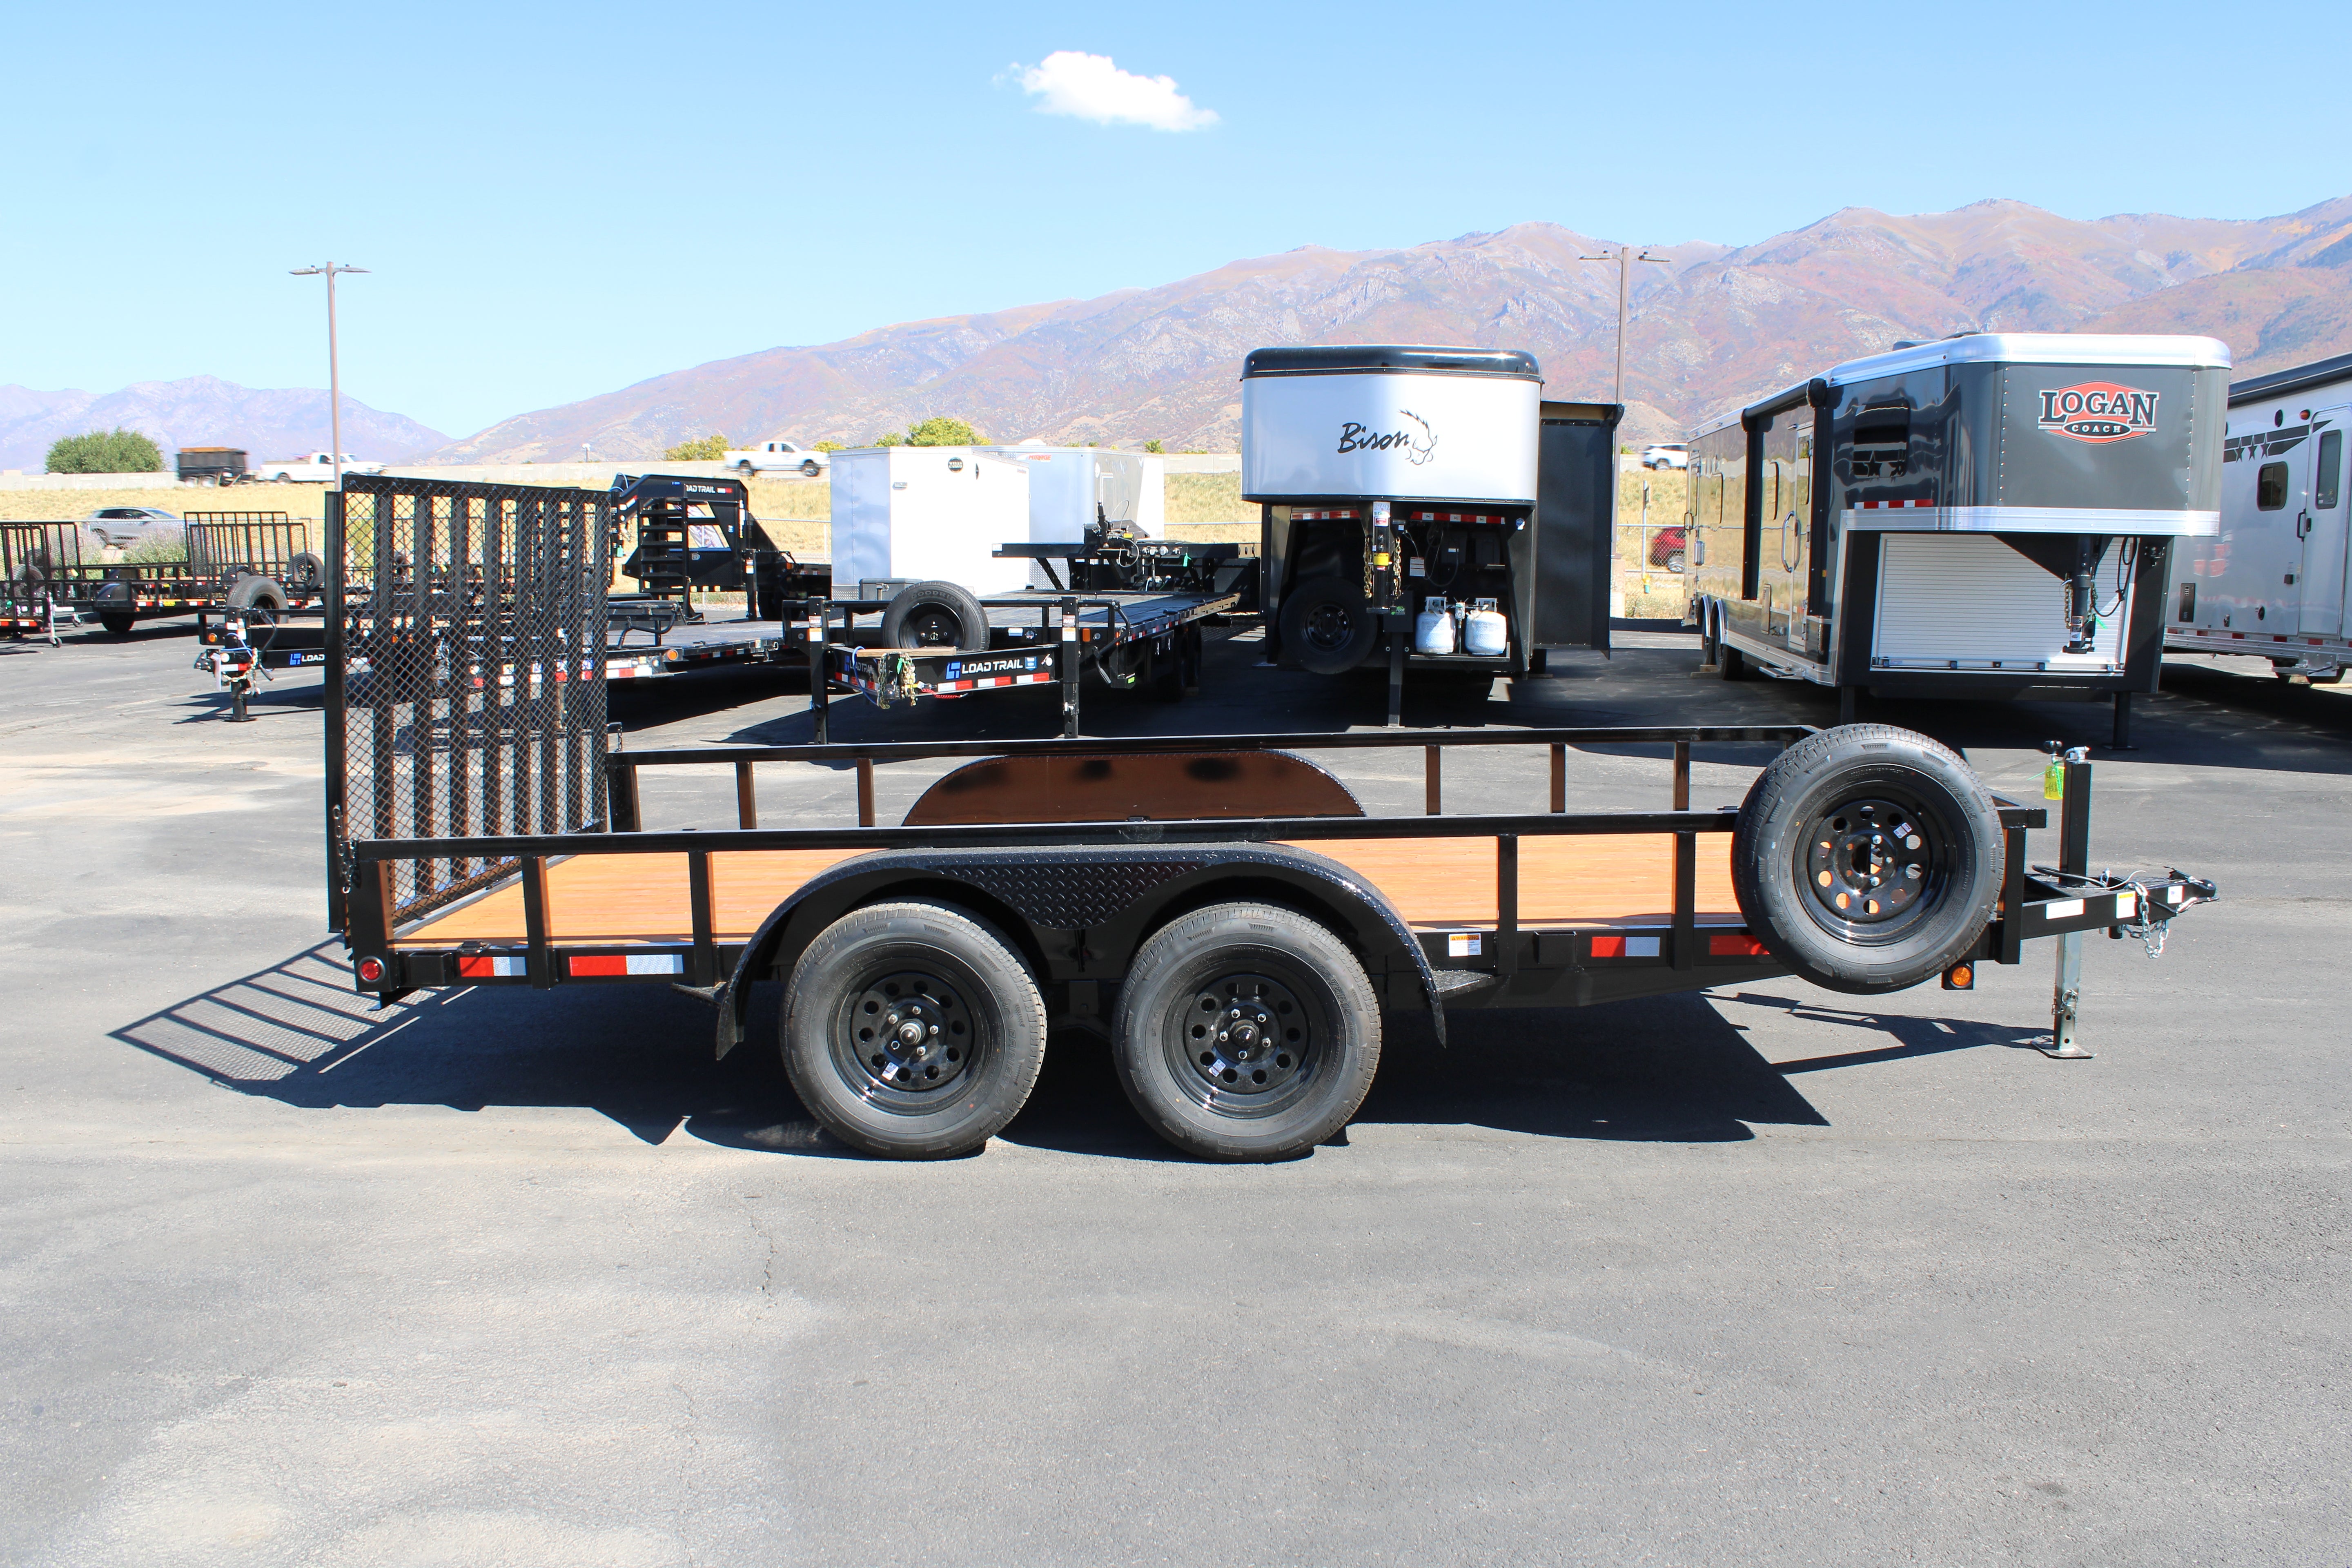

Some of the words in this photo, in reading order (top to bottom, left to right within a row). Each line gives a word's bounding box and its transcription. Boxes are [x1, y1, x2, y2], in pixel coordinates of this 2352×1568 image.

[2038, 390, 2160, 427] LOGAN
[2071, 425, 2121, 433] COACH
[1338, 422, 1409, 453] Bison
[911, 589, 963, 607] GOODRIDE
[301, 654, 325, 662] LOAD
[962, 662, 992, 674] LOAD
[993, 659, 1023, 671] TRAIL
[1134, 1046, 1144, 1062] ST
